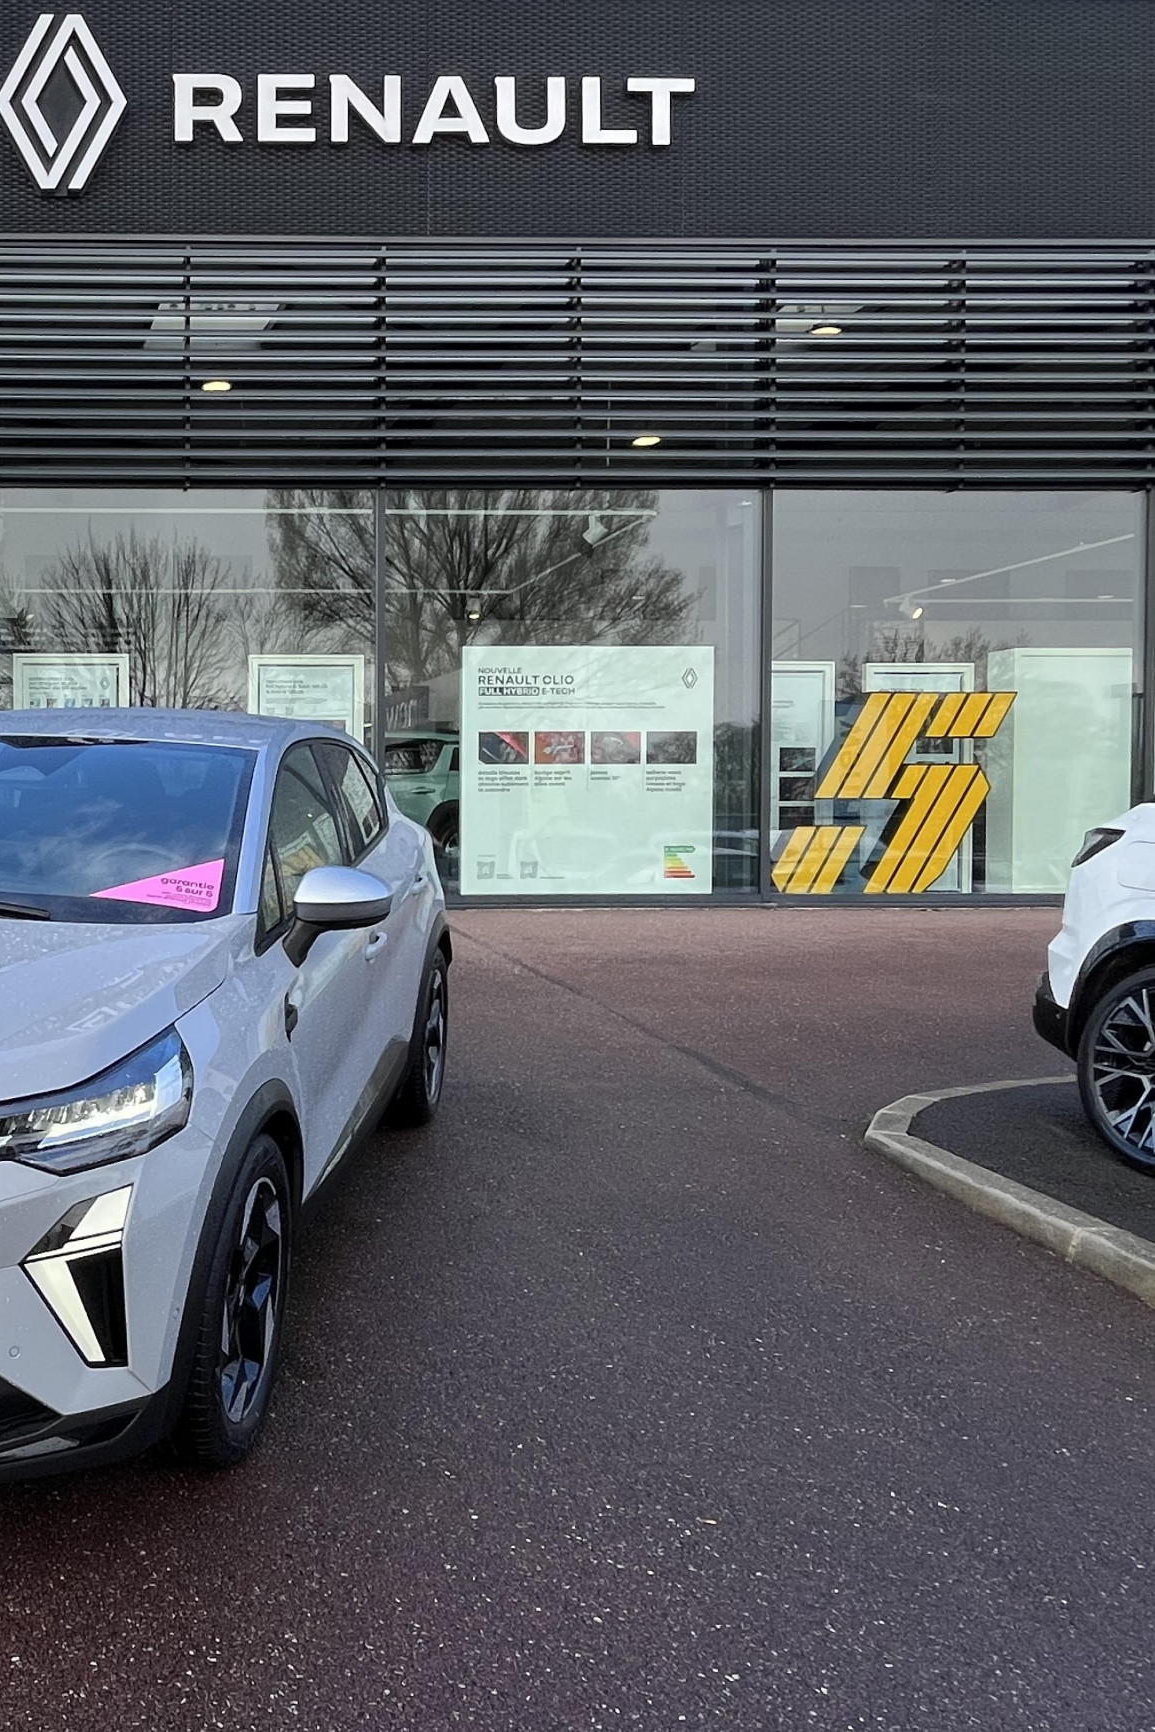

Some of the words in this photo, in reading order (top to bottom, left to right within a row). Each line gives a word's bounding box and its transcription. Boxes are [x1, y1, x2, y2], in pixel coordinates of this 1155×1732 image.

[172, 73, 696, 147] RENAULT
[478, 675, 540, 685] RENAULT
[542, 675, 574, 685] CLIO
[479, 687, 503, 695] FULL
[503, 687, 539, 695] HYBRID
[541, 687, 575, 695] E-TECH
[160, 877, 214, 889] garantie
